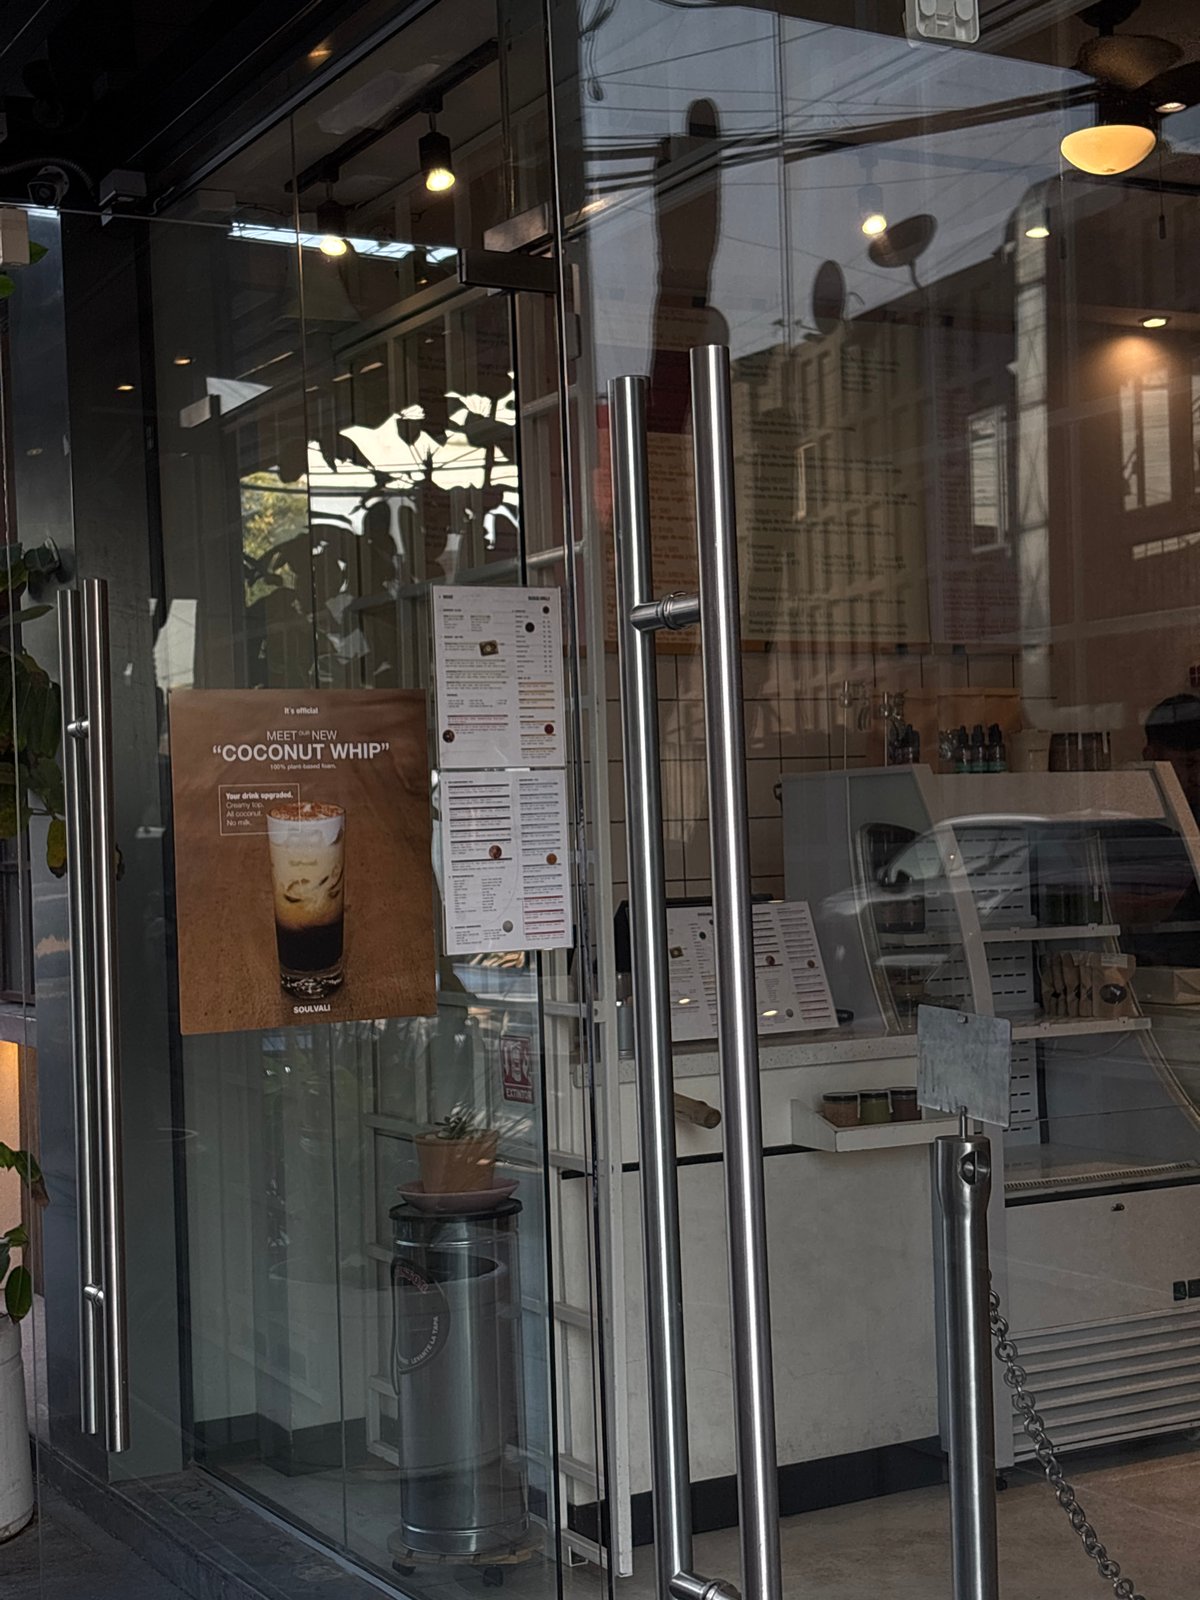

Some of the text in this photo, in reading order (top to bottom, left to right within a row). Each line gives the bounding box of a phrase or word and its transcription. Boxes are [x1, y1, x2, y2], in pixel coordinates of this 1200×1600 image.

[296, 706, 319, 715] official
[266, 730, 298, 742] MEET
[311, 729, 338, 741] NEW
[213, 742, 390, 762] “COCONUT WHIP”
[287, 763, 321, 771] plant-based
[225, 791, 294, 800] Your drink upgraded.
[225, 801, 265, 810] Creamy top.
[236, 810, 263, 818] coconut.
[226, 819, 251, 827] No milk.
[293, 1003, 331, 1014] SOULVALI
